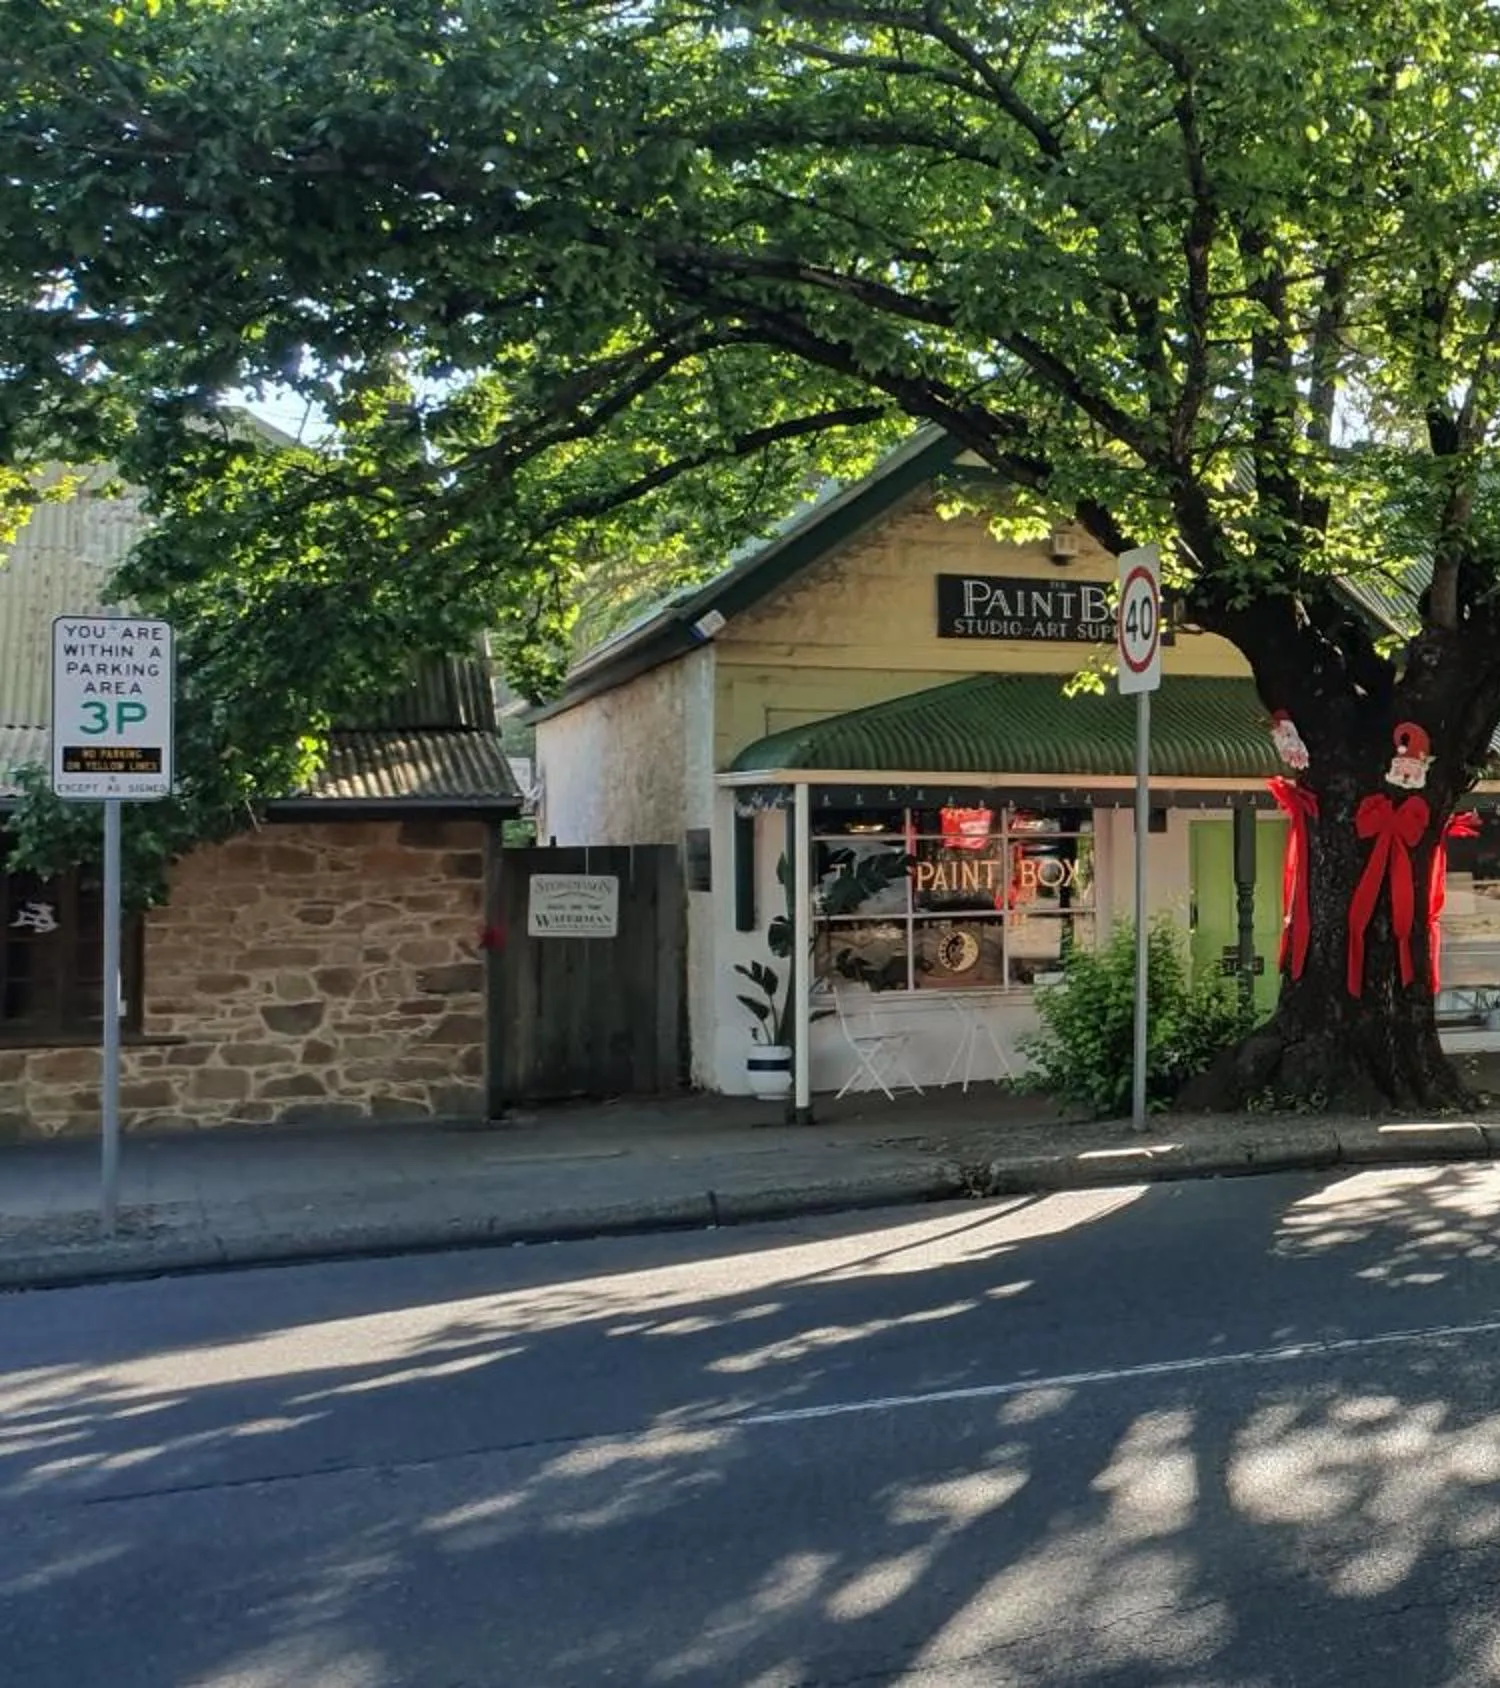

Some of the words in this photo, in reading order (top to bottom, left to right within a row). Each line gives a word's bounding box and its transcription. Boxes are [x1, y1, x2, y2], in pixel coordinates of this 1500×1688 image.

[1126, 596, 1151, 643] 40
[64, 625, 106, 638] YOU
[121, 627, 163, 640] ARE
[64, 643, 134, 657] WITHIN
[149, 646, 162, 658] A
[66, 661, 160, 677] PARKING
[83, 681, 142, 695] AREA
[79, 701, 147, 735] 3P
[100, 749, 143, 760] PARKING
[85, 760, 125, 772] YELLOW
[57, 783, 98, 792] EXCEPT
[916, 859, 1001, 892] PAINT
[1020, 859, 1084, 887] BOX
